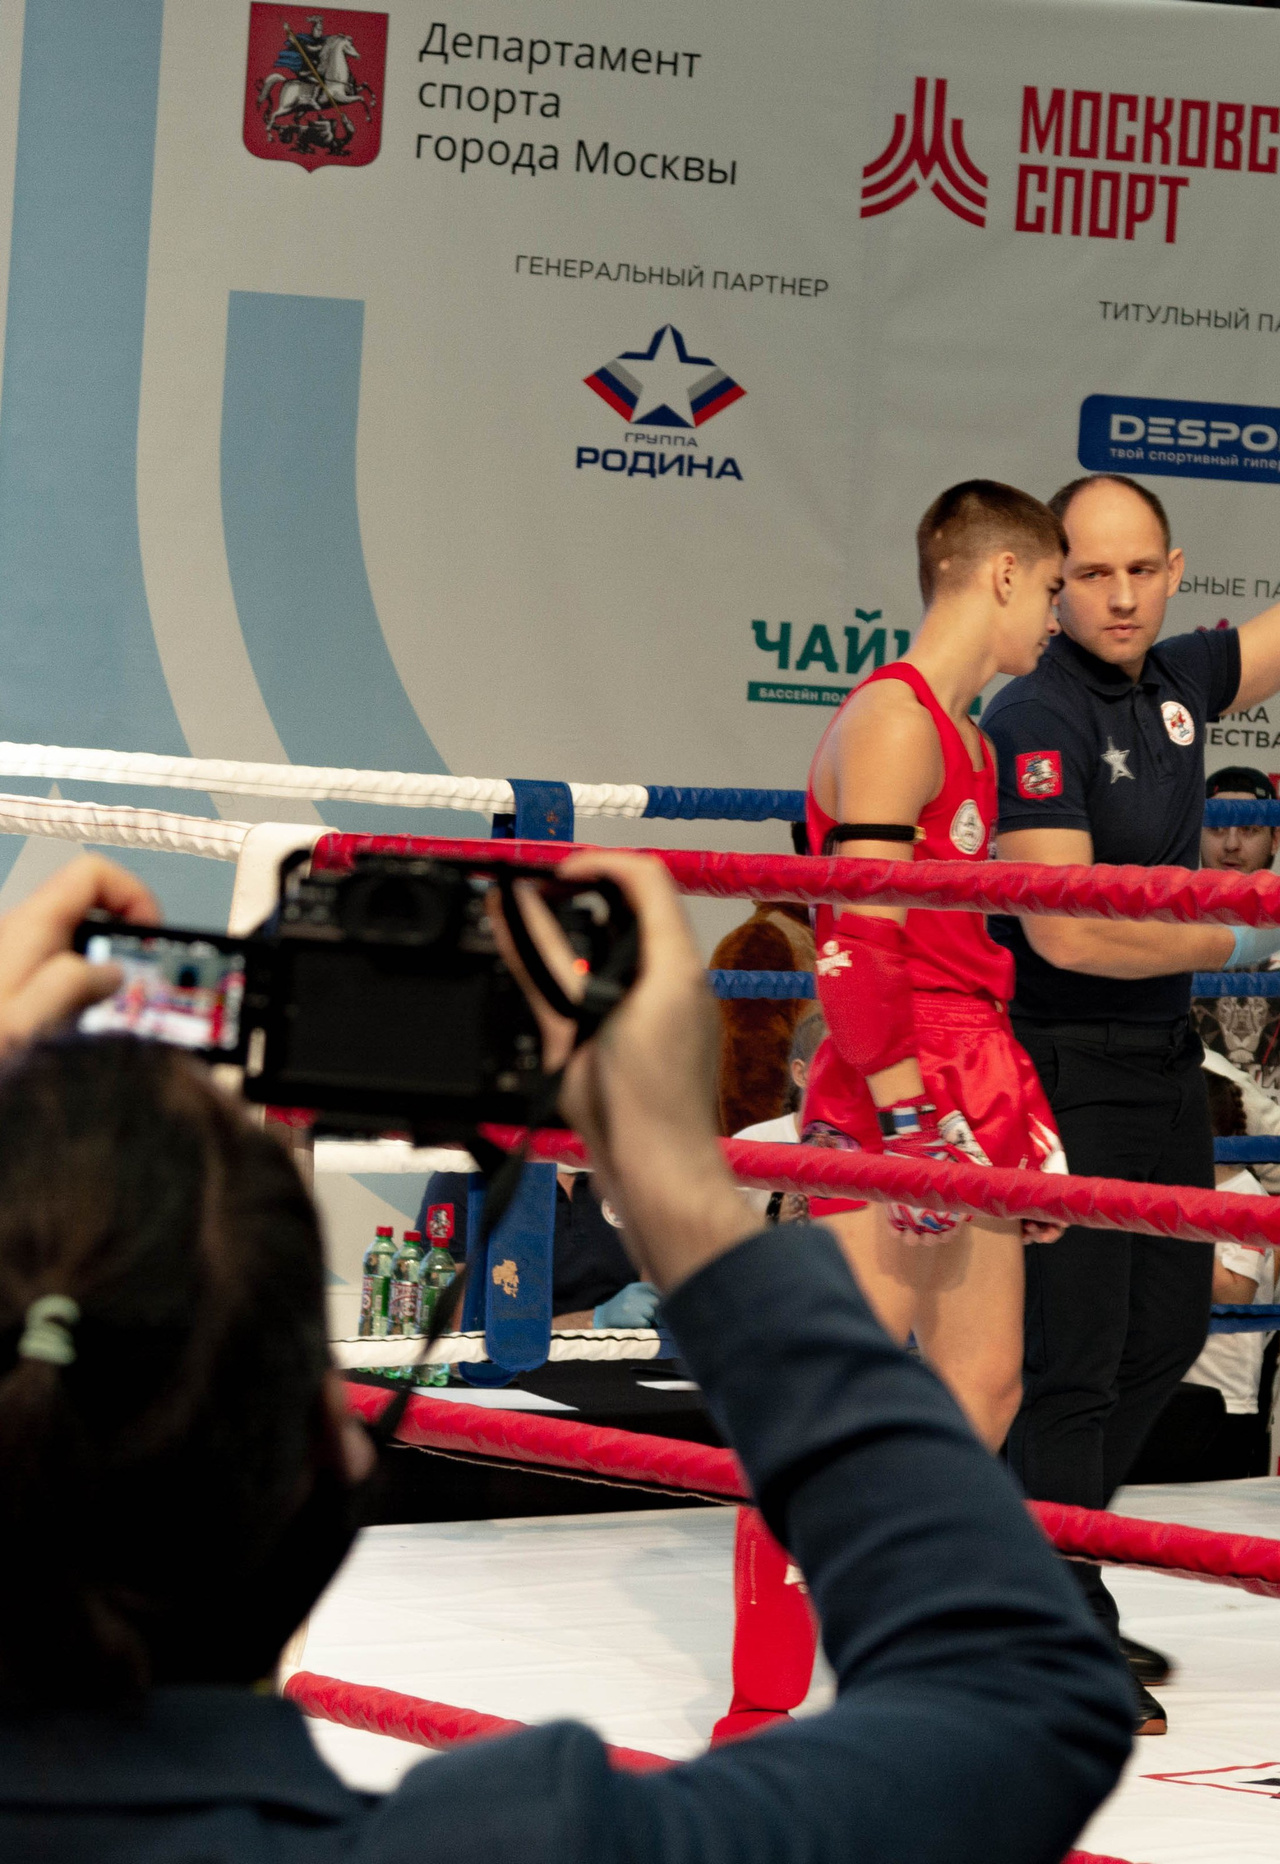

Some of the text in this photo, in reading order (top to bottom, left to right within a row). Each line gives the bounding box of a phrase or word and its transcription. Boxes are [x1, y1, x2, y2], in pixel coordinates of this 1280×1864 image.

[418, 22, 702, 78] Департамент
[418, 81, 561, 123] спорта
[415, 133, 737, 185] города Москвы
[1015, 163, 1190, 244] СПОРТ
[515, 254, 830, 298] ГЕНЕРАЛЬНЫЙ ПАРТНЕР
[1099, 300, 1251, 331] ТИТУЛЬНЫЙ
[624, 432, 699, 448] ГРУППА
[1109, 447, 1144, 460] твой
[1149, 449, 1239, 467] спортивный
[575, 446, 744, 481] РОДИНА
[758, 687, 819, 702] БАССЕЙН
